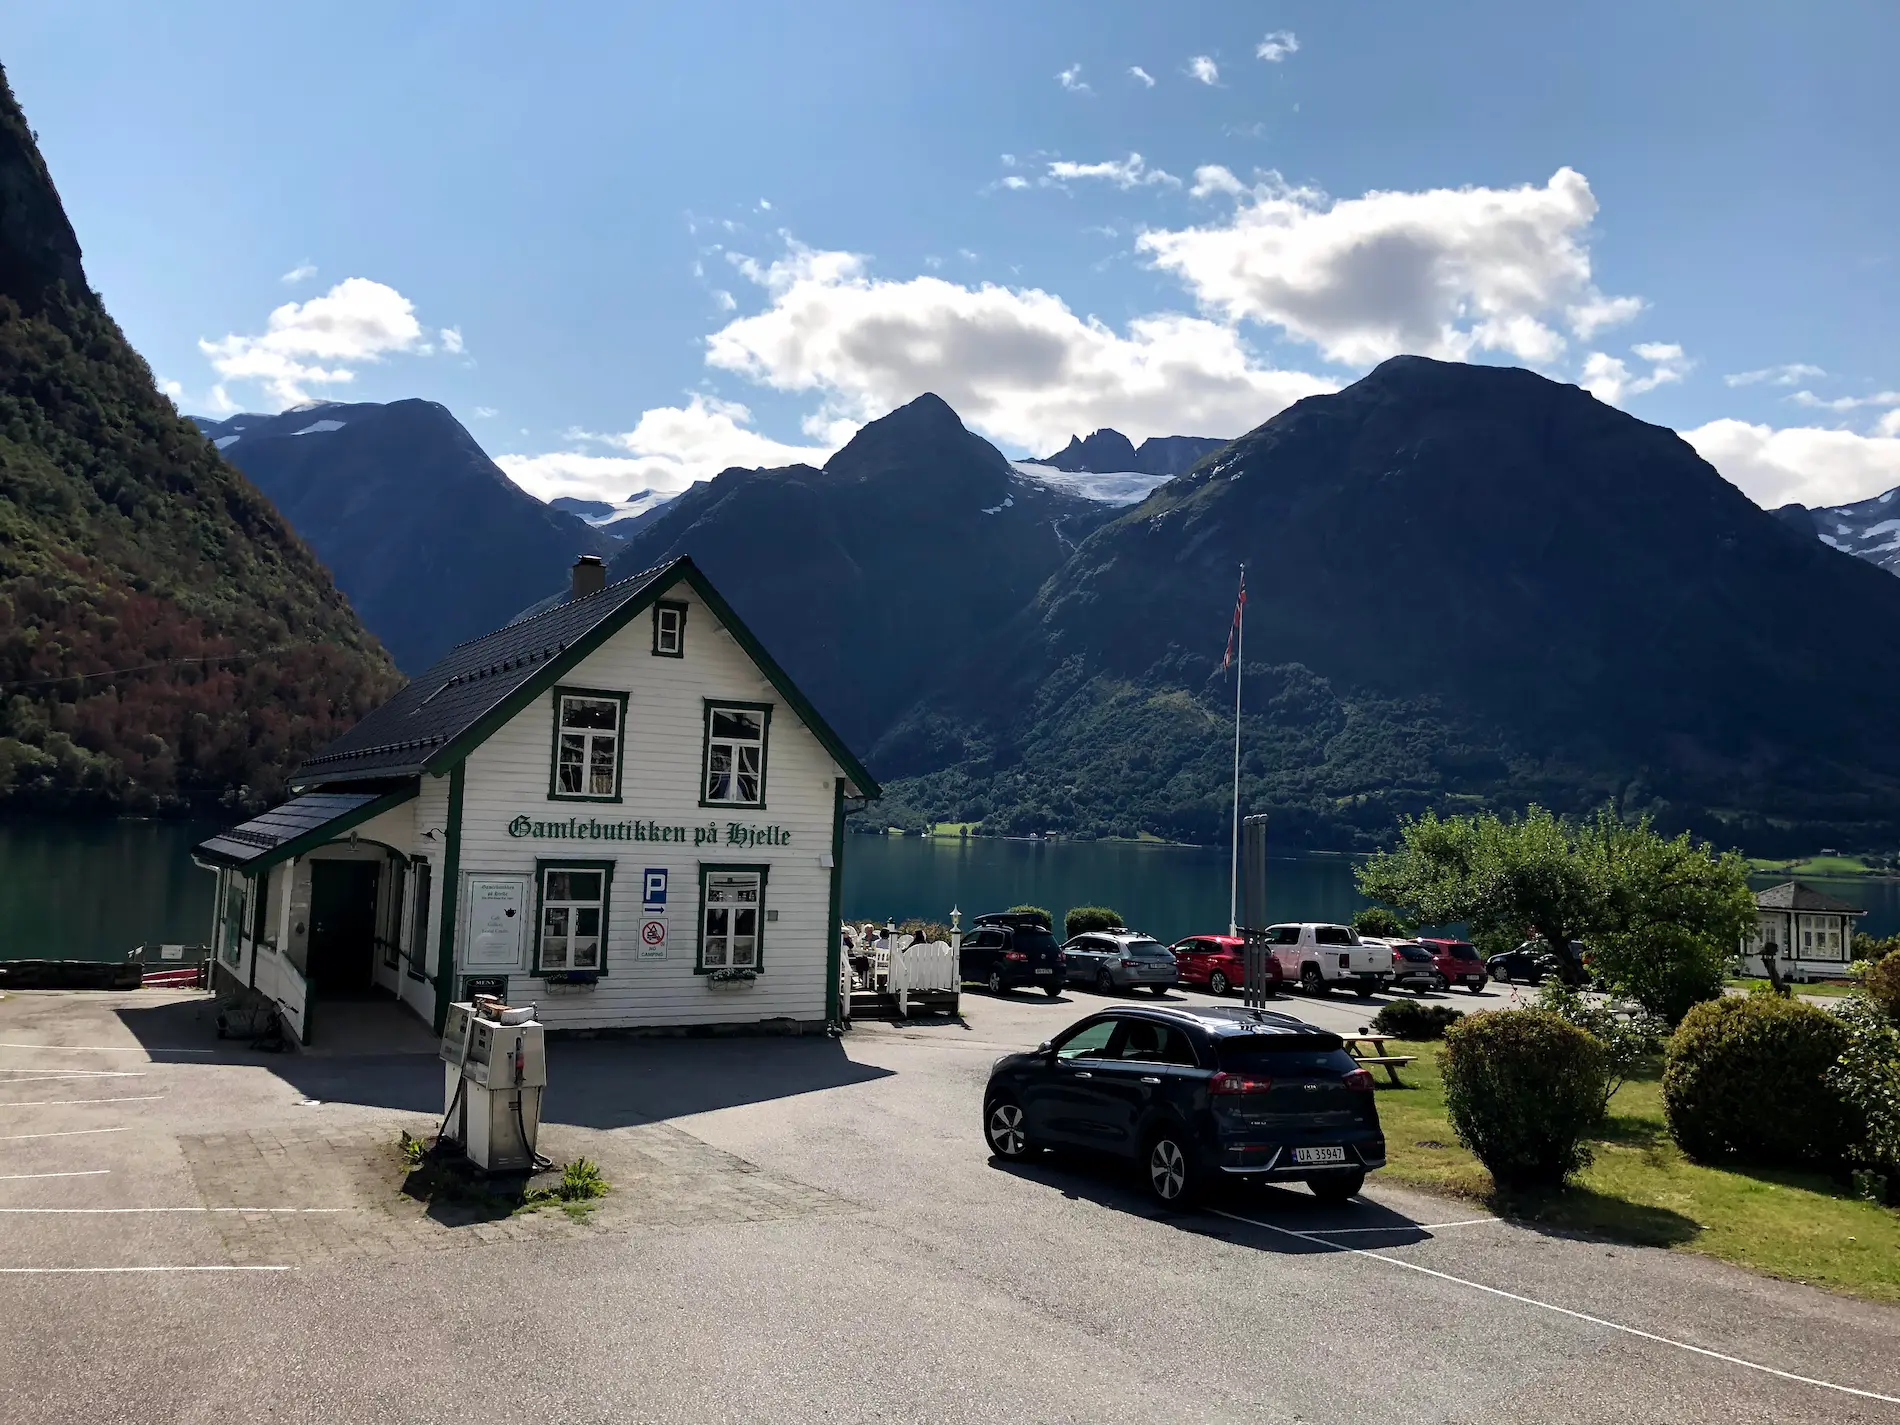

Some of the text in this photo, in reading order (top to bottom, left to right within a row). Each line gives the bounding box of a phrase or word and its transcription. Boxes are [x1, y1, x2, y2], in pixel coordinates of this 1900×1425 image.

[508, 814, 792, 848] Gamlebutikken på Hjelle
[645, 873, 666, 900] P
[1299, 1148, 1343, 1161] UA 35947
